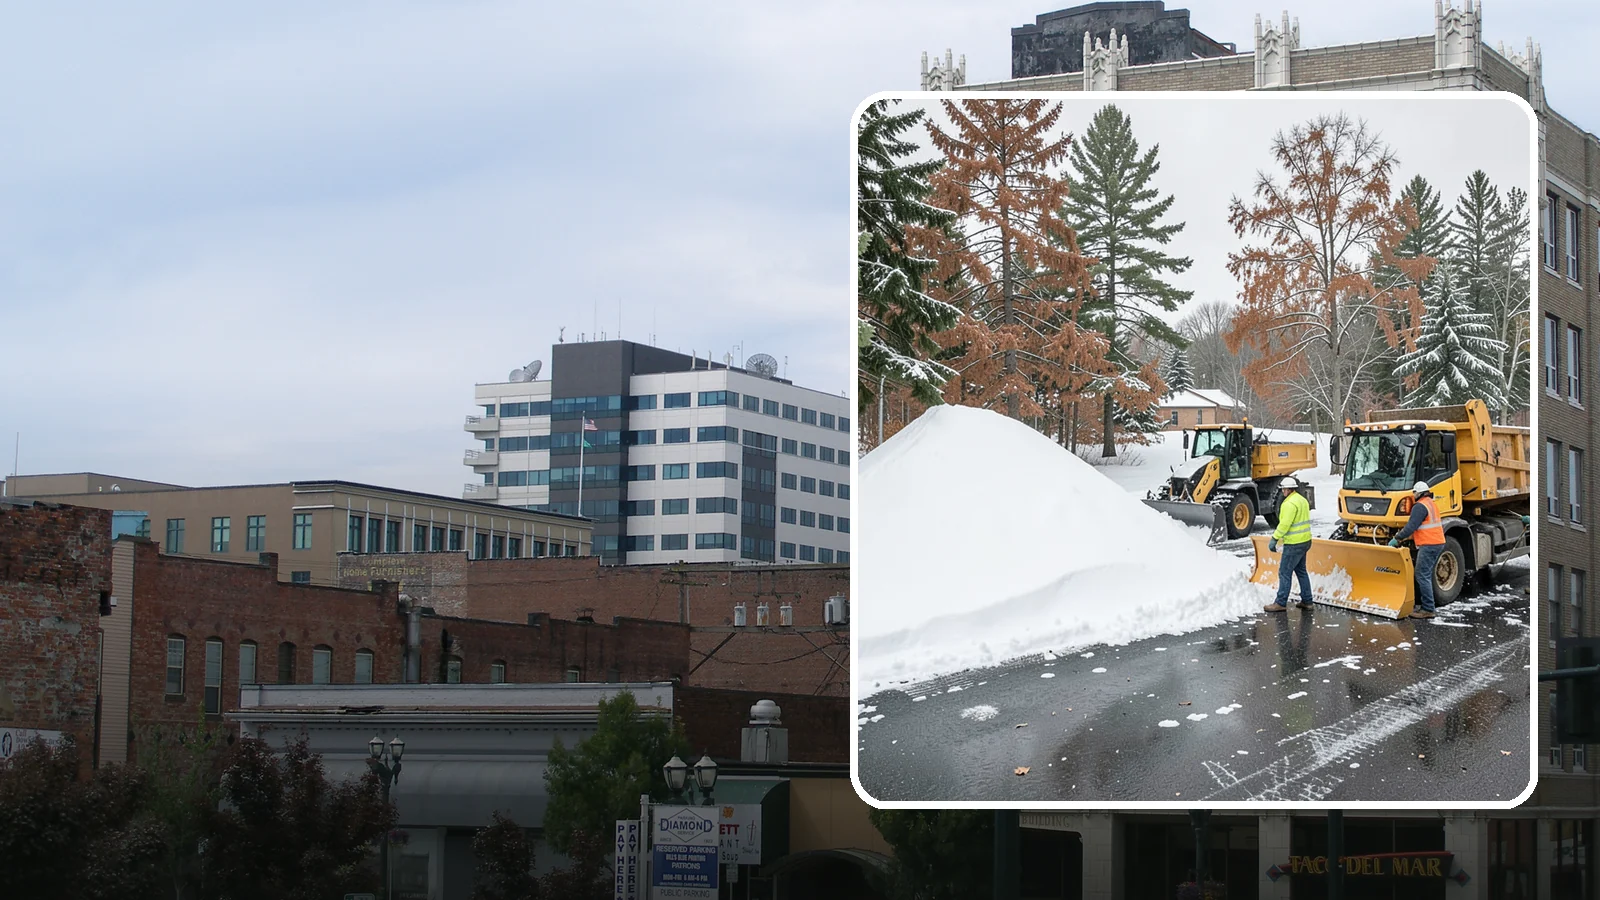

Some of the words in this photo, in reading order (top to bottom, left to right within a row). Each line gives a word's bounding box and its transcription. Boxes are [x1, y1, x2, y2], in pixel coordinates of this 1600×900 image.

[343, 568, 368, 577] Home
[370, 566, 427, 576] Furnishers
[660, 818, 713, 833] DIAMOND
[1022, 815, 1070, 827] BUILDING
[719, 824, 740, 835] ETT
[617, 825, 625, 852] PAY
[628, 824, 637, 852] PAY
[656, 845, 688, 853] RESERVED
[689, 846, 716, 854] PARKING
[721, 851, 739, 863] Soup
[671, 862, 701, 870] PATRONS
[1288, 855, 1331, 875] TAC
[1346, 856, 1385, 876] DEL
[1392, 857, 1442, 877] MAR
[616, 856, 625, 894] HERE
[627, 855, 636, 893] HERE
[660, 888, 682, 897] PUBLIC
[683, 889, 710, 898] PARKING
